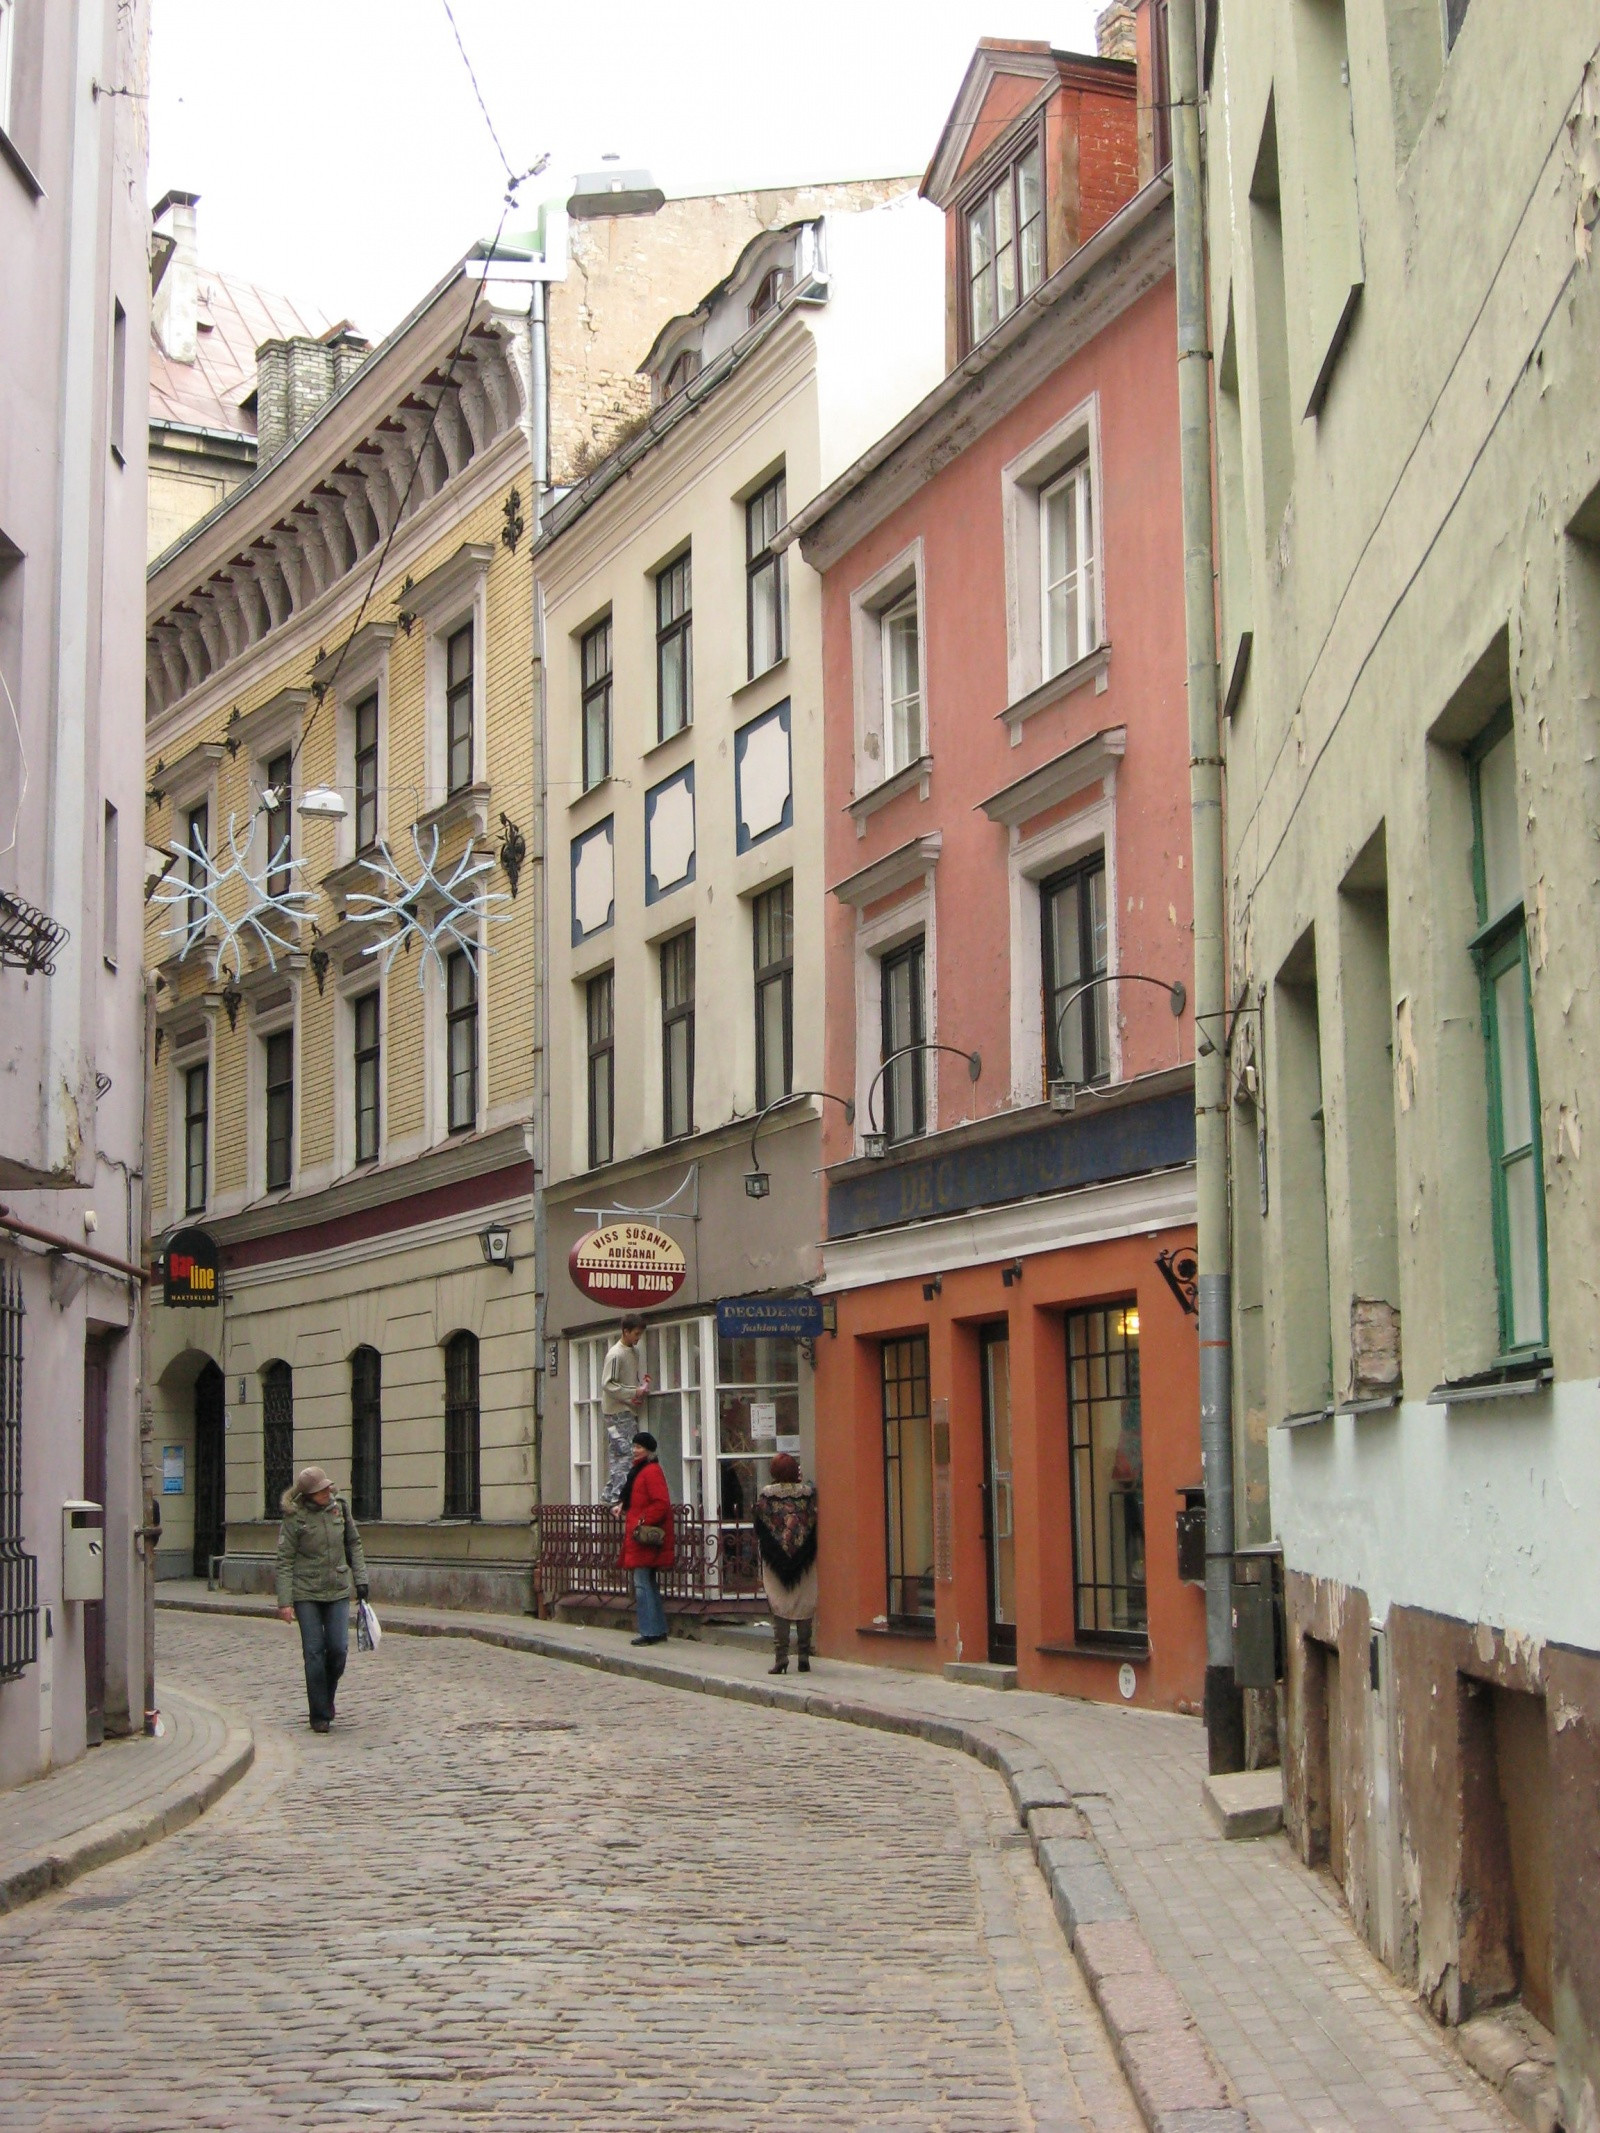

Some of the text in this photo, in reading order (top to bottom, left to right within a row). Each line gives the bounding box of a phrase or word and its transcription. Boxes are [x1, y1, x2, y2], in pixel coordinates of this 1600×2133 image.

[593, 1231, 618, 1249] VISS
[190, 1265, 214, 1289] line
[588, 1272, 674, 1292] AUDUMI, DZIJAS
[724, 1305, 817, 1318] DECADENCE
[741, 1323, 802, 1334] fashion shop
